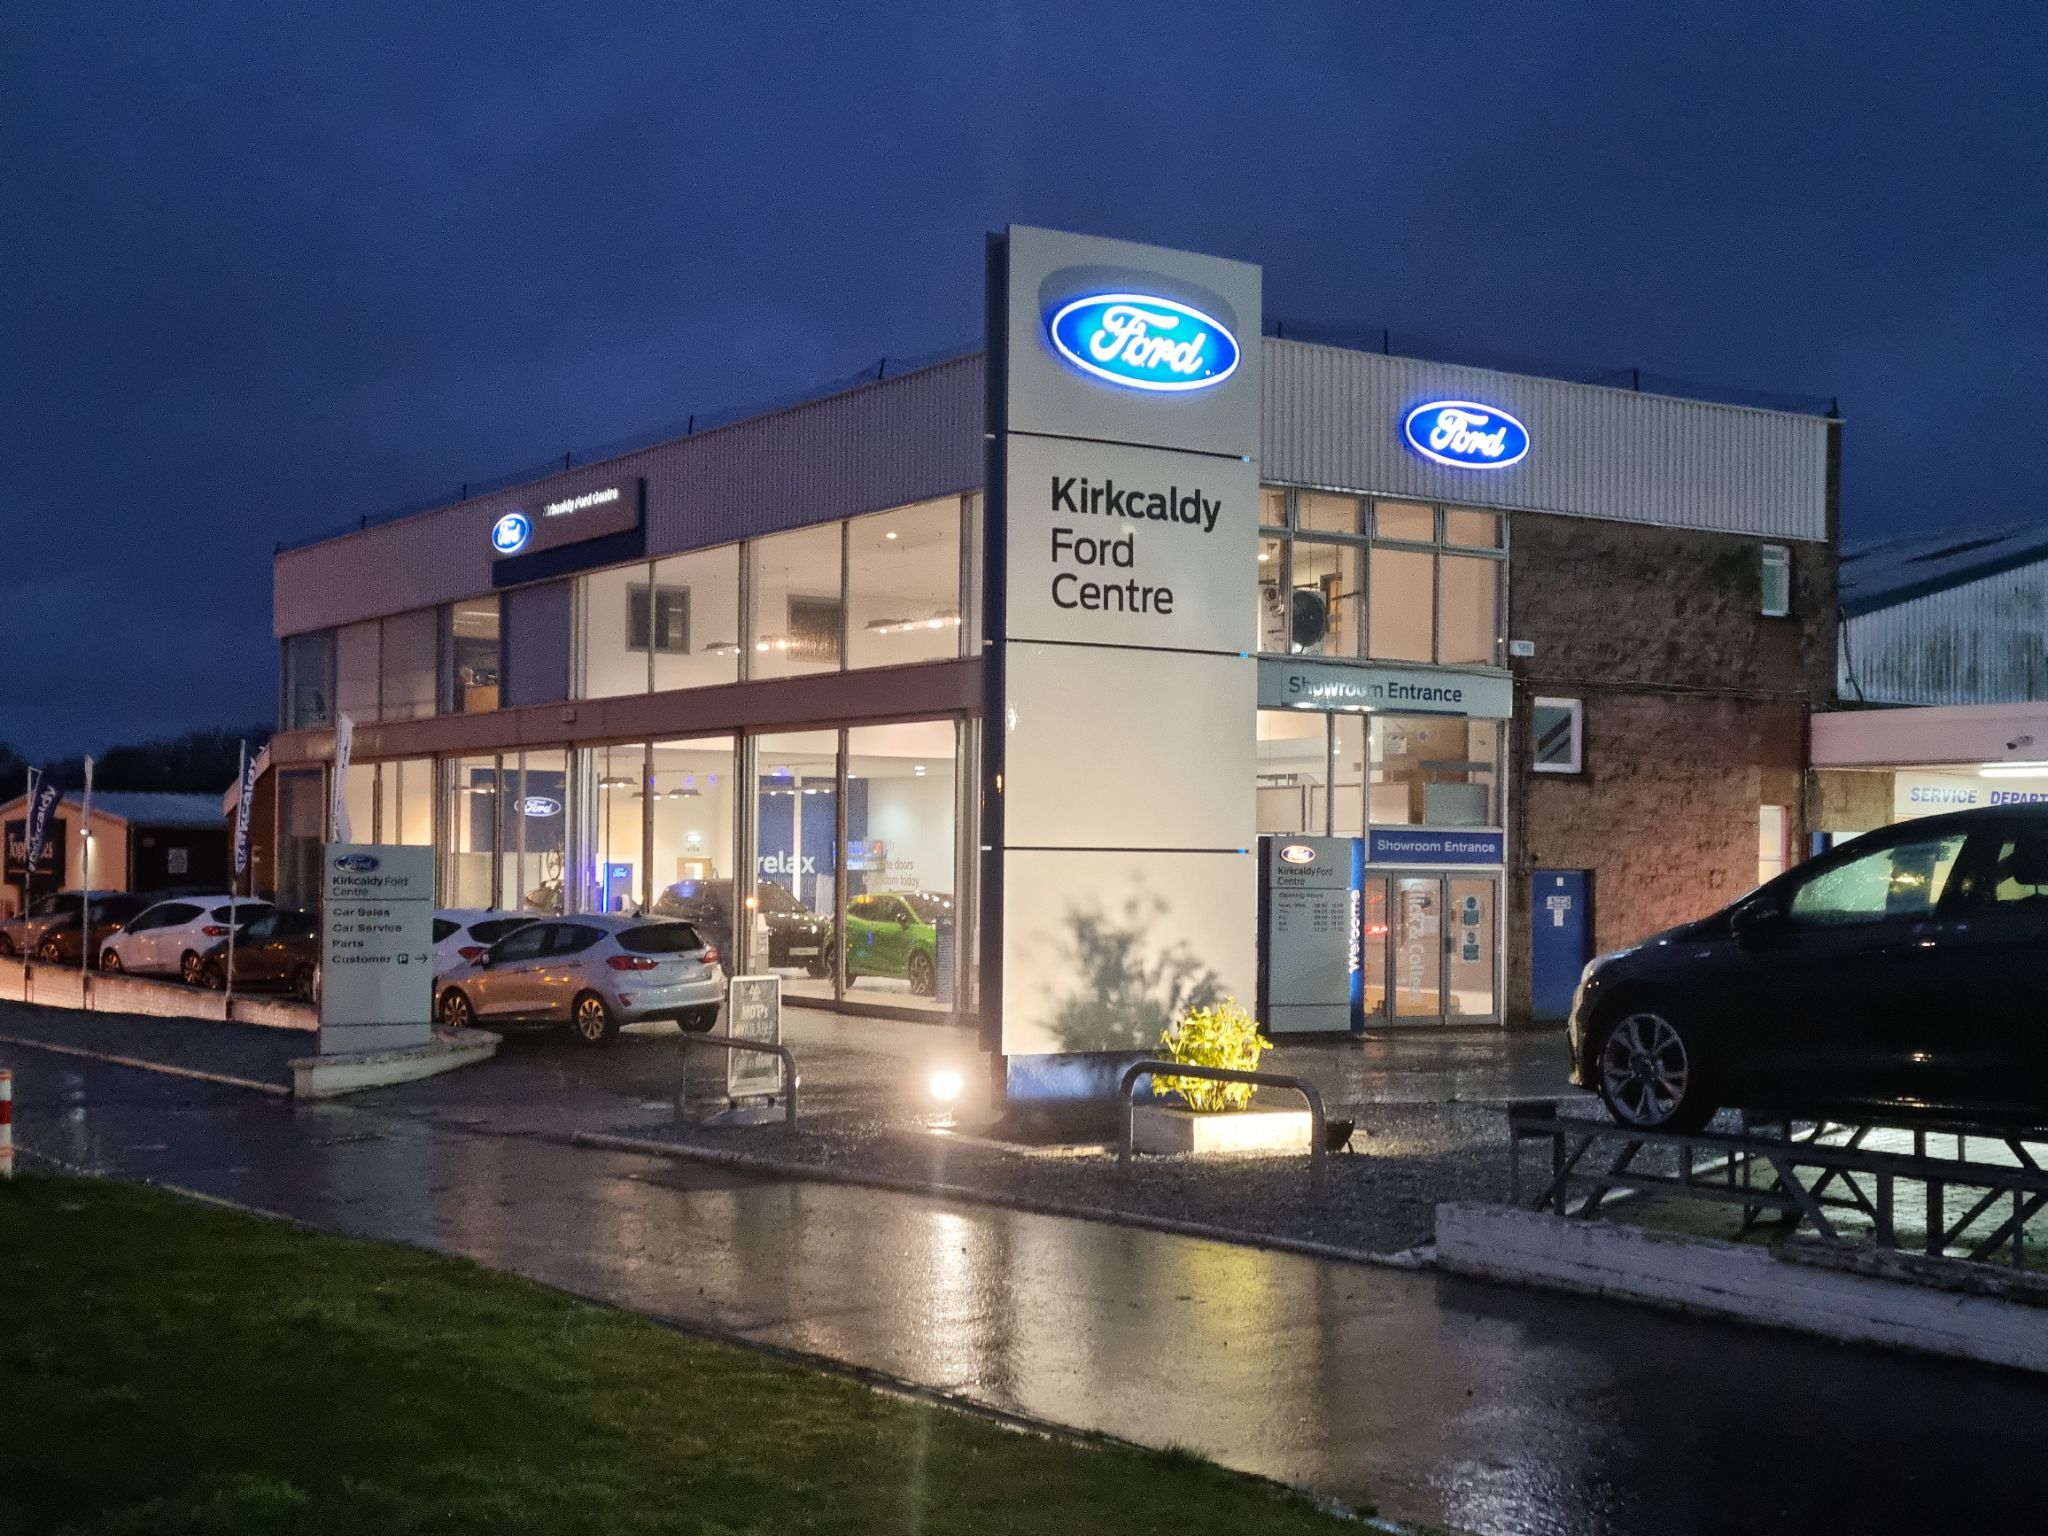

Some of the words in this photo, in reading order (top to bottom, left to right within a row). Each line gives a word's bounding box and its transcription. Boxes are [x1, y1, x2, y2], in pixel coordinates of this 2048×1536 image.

[1090, 305, 1207, 374] Ford
[1429, 408, 1507, 457] Ford
[1052, 475, 1221, 533] Kirkcaldy
[1052, 527, 1134, 568] Ford
[1051, 572, 1174, 615] Centre
[1289, 676, 1384, 699] Showroom
[1388, 682, 1463, 703] Entrance
[1911, 787, 1978, 804] SERVICE
[1377, 840, 1441, 852] Showroom
[1444, 841, 1496, 853] Entrance
[758, 851, 815, 874] relax
[1278, 867, 1315, 876] Kirkcaldy
[1317, 868, 1333, 876] Ford
[333, 876, 382, 887] Kirkcaldy
[384, 876, 407, 886] Ford
[1277, 877, 1305, 886] Centre
[333, 887, 368, 896] Centre
[333, 908, 354, 917] Car
[357, 908, 390, 917] Sales
[333, 923, 353, 932] Car
[357, 923, 402, 933] Service
[1349, 889, 1360, 973] Welcome
[332, 940, 364, 948] Parts
[332, 955, 391, 964] Customer
